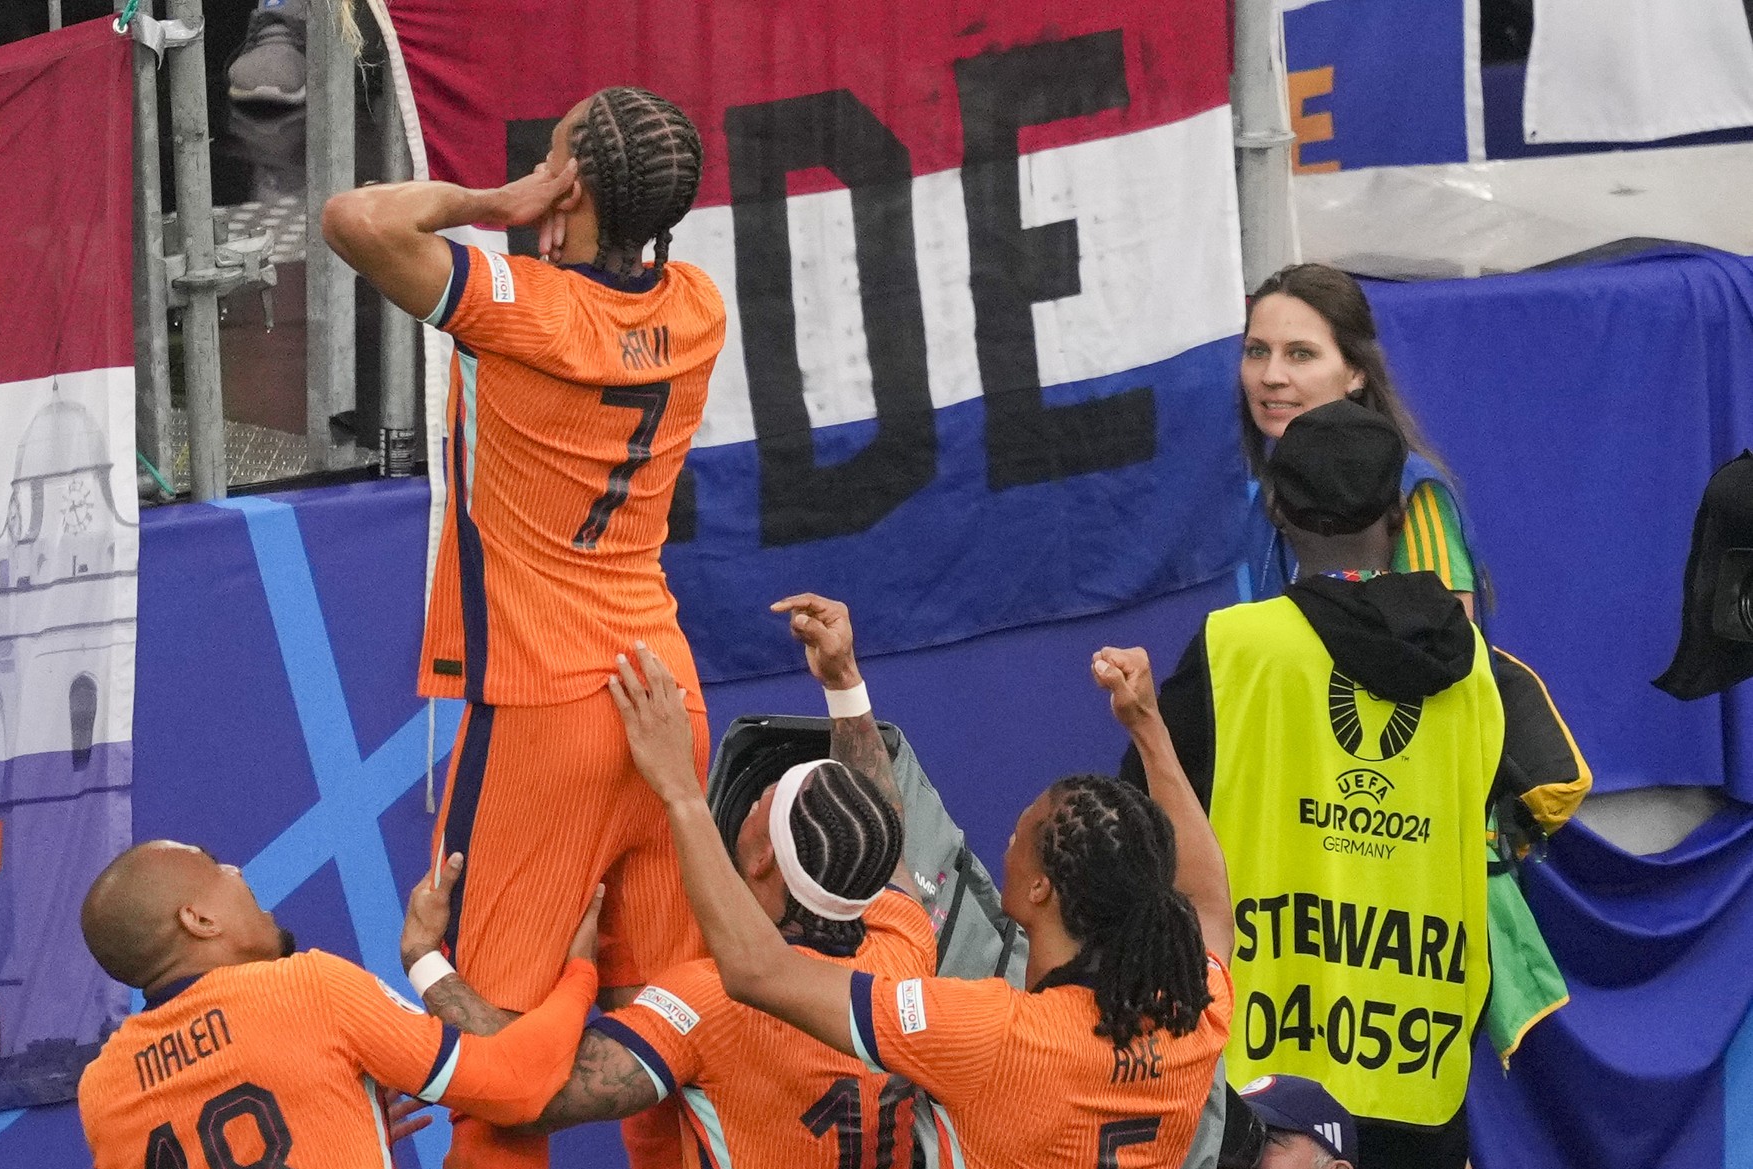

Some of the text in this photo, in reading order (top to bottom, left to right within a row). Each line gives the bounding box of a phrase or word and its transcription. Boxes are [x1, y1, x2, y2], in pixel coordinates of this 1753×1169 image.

[574, 381, 671, 550] 7
[1337, 773, 1388, 800] UEFA
[1299, 798, 1431, 843] EURO2024
[1322, 836, 1396, 860] GERMANY
[134, 1008, 232, 1092] MALEN
[1246, 984, 1463, 1079] 04-0597
